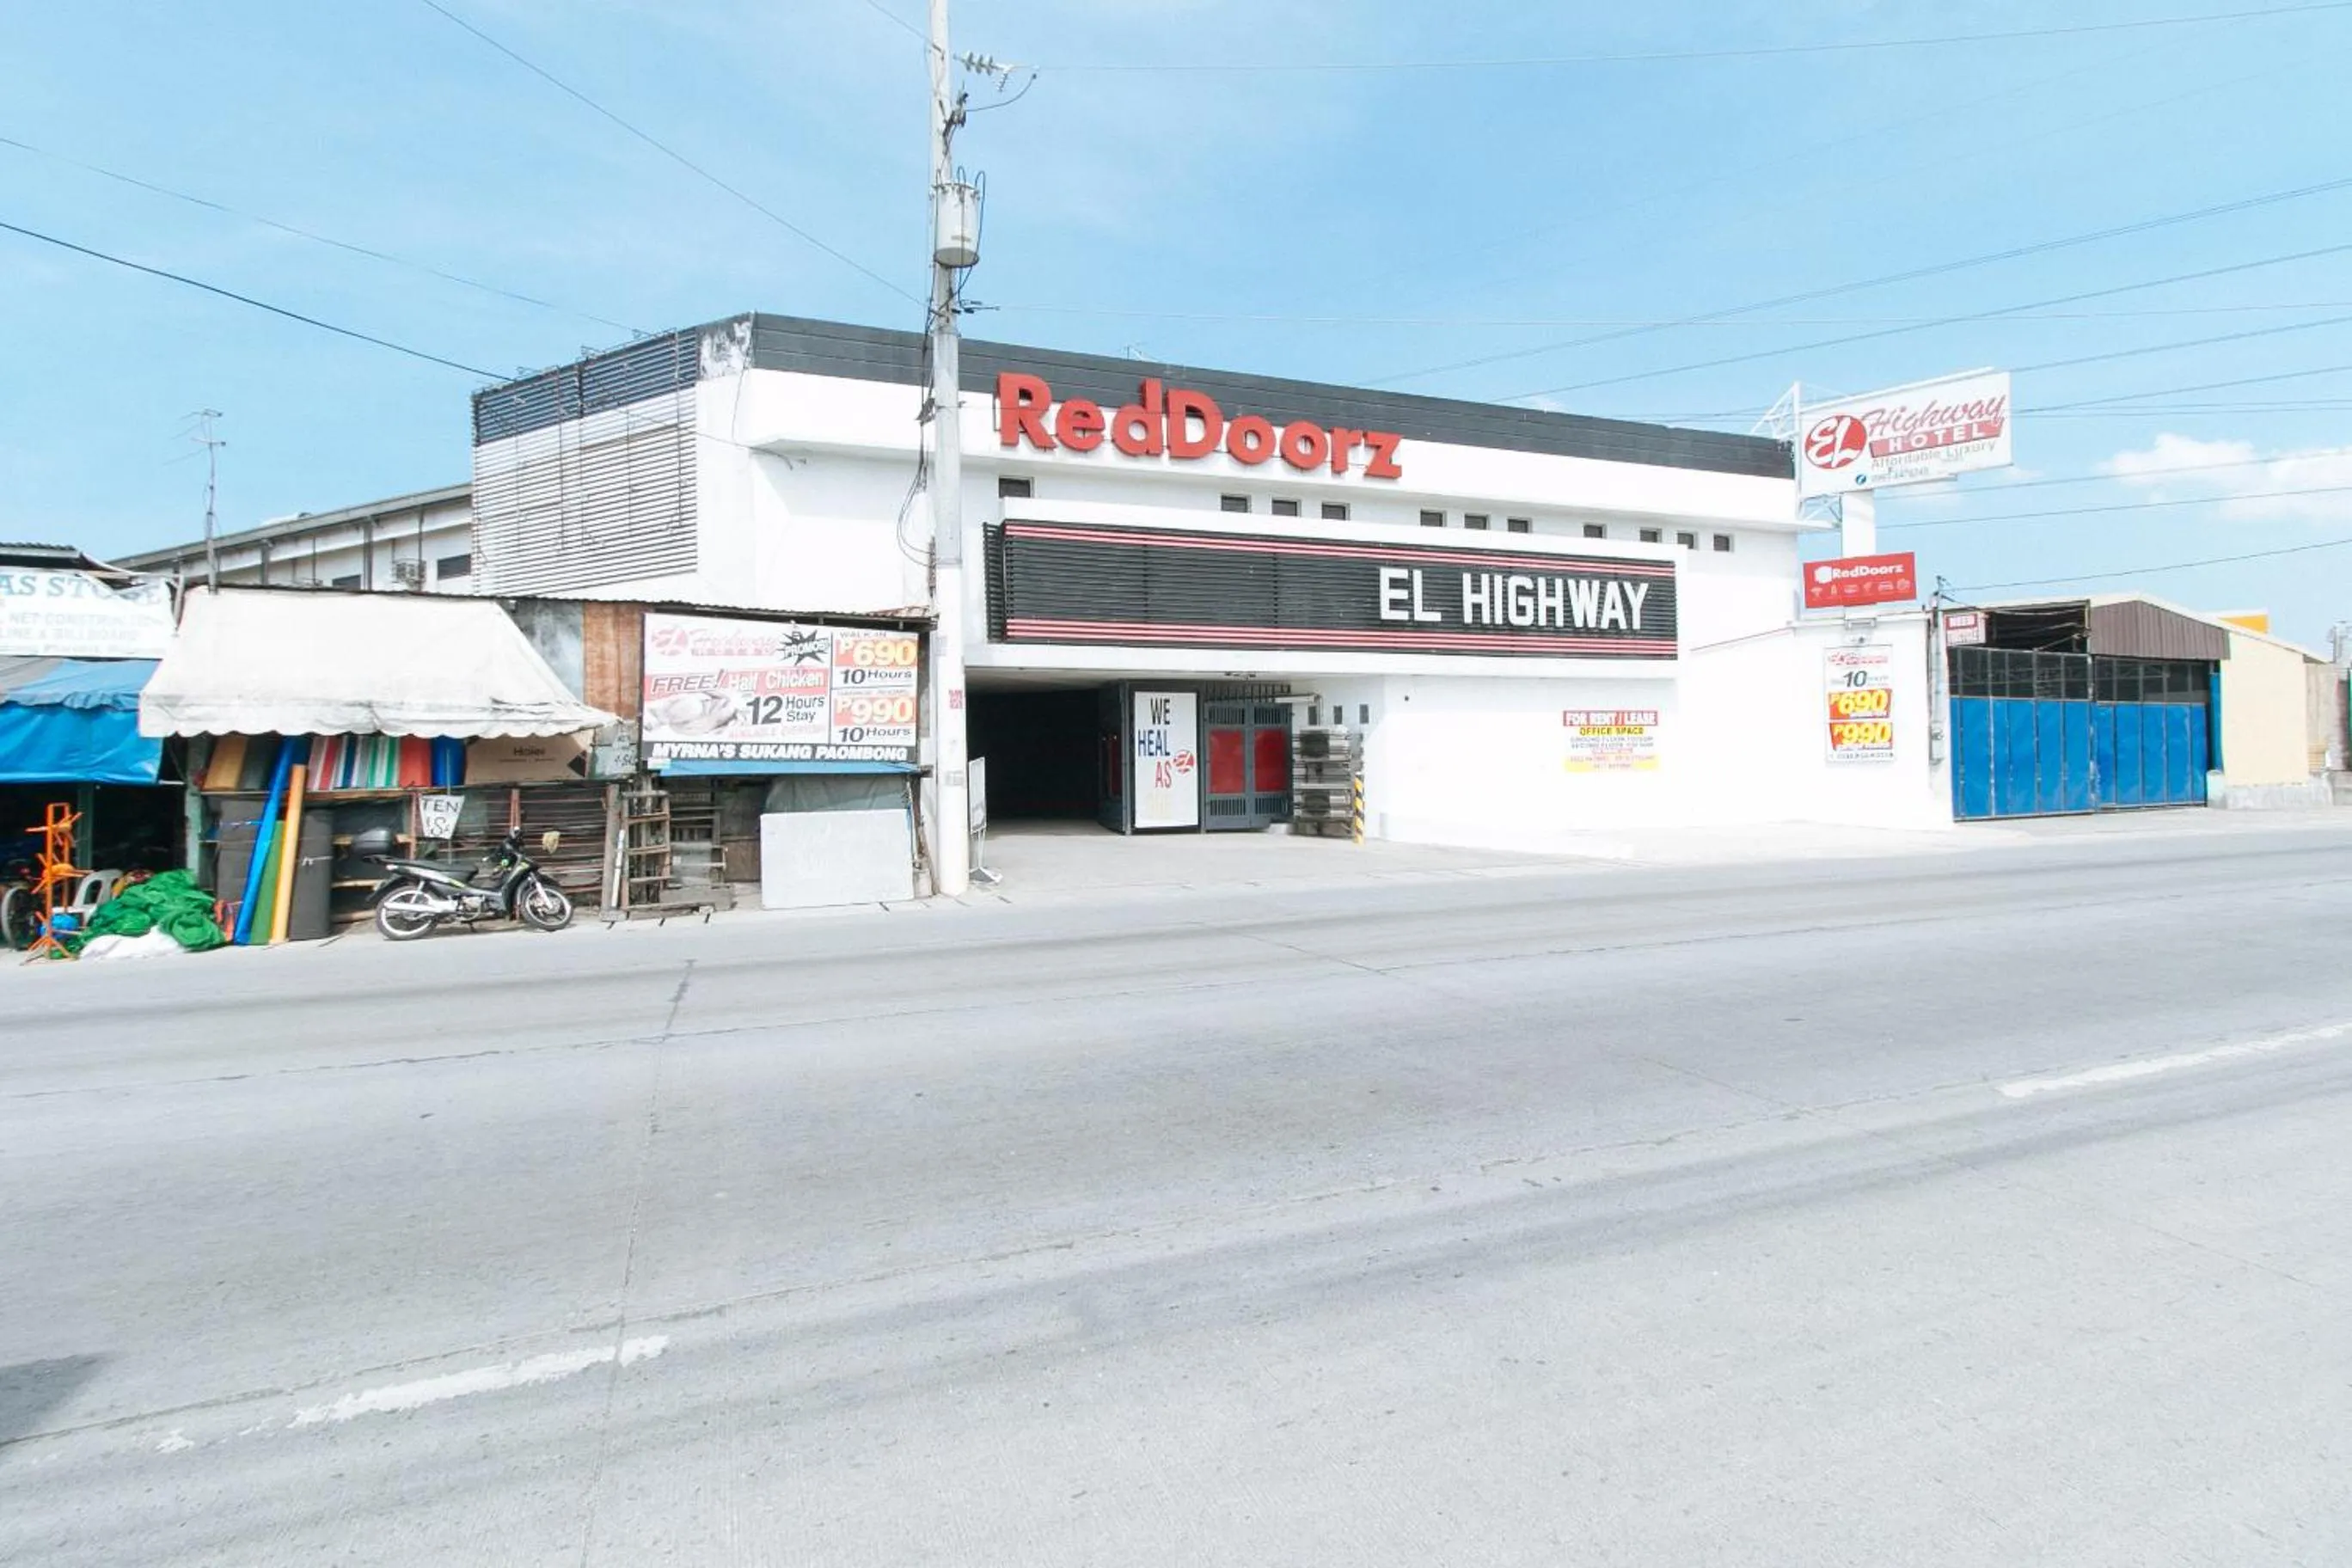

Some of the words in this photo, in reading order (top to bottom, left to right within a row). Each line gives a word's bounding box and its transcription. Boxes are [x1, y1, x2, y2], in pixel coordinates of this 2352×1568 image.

[995, 371, 1402, 479] RedDoorz
[1861, 394, 2006, 438] Highway
[1888, 424, 1985, 453] HOTEL
[1871, 449, 1941, 469] Affordable
[1833, 564, 1904, 579] RedDoorz
[1379, 567, 1441, 622] EL
[1462, 572, 1648, 629] HIGHWAY
[652, 669, 726, 693] FREE!
[766, 669, 824, 689] Chicken
[842, 669, 866, 684] 10
[867, 669, 913, 679] Hours
[1843, 670, 1867, 688] 10
[746, 695, 783, 726] 12
[785, 695, 825, 710] Hours
[787, 709, 816, 723] Stay
[1150, 696, 1172, 726] WE
[1566, 712, 1587, 726] FOR
[1589, 712, 1616, 726] RENT
[1624, 712, 1656, 726] LEASE
[838, 726, 865, 743] 10
[866, 727, 913, 737] Hours
[1579, 726, 1612, 736] OFFICE
[652, 743, 737, 759] MYRNA'S
[738, 744, 812, 759] SUKANG
[815, 744, 909, 761] PAOMBONG
[1137, 728, 1172, 757] HEAL
[1155, 760, 1173, 789] AS
[421, 797, 459, 813] TEN
